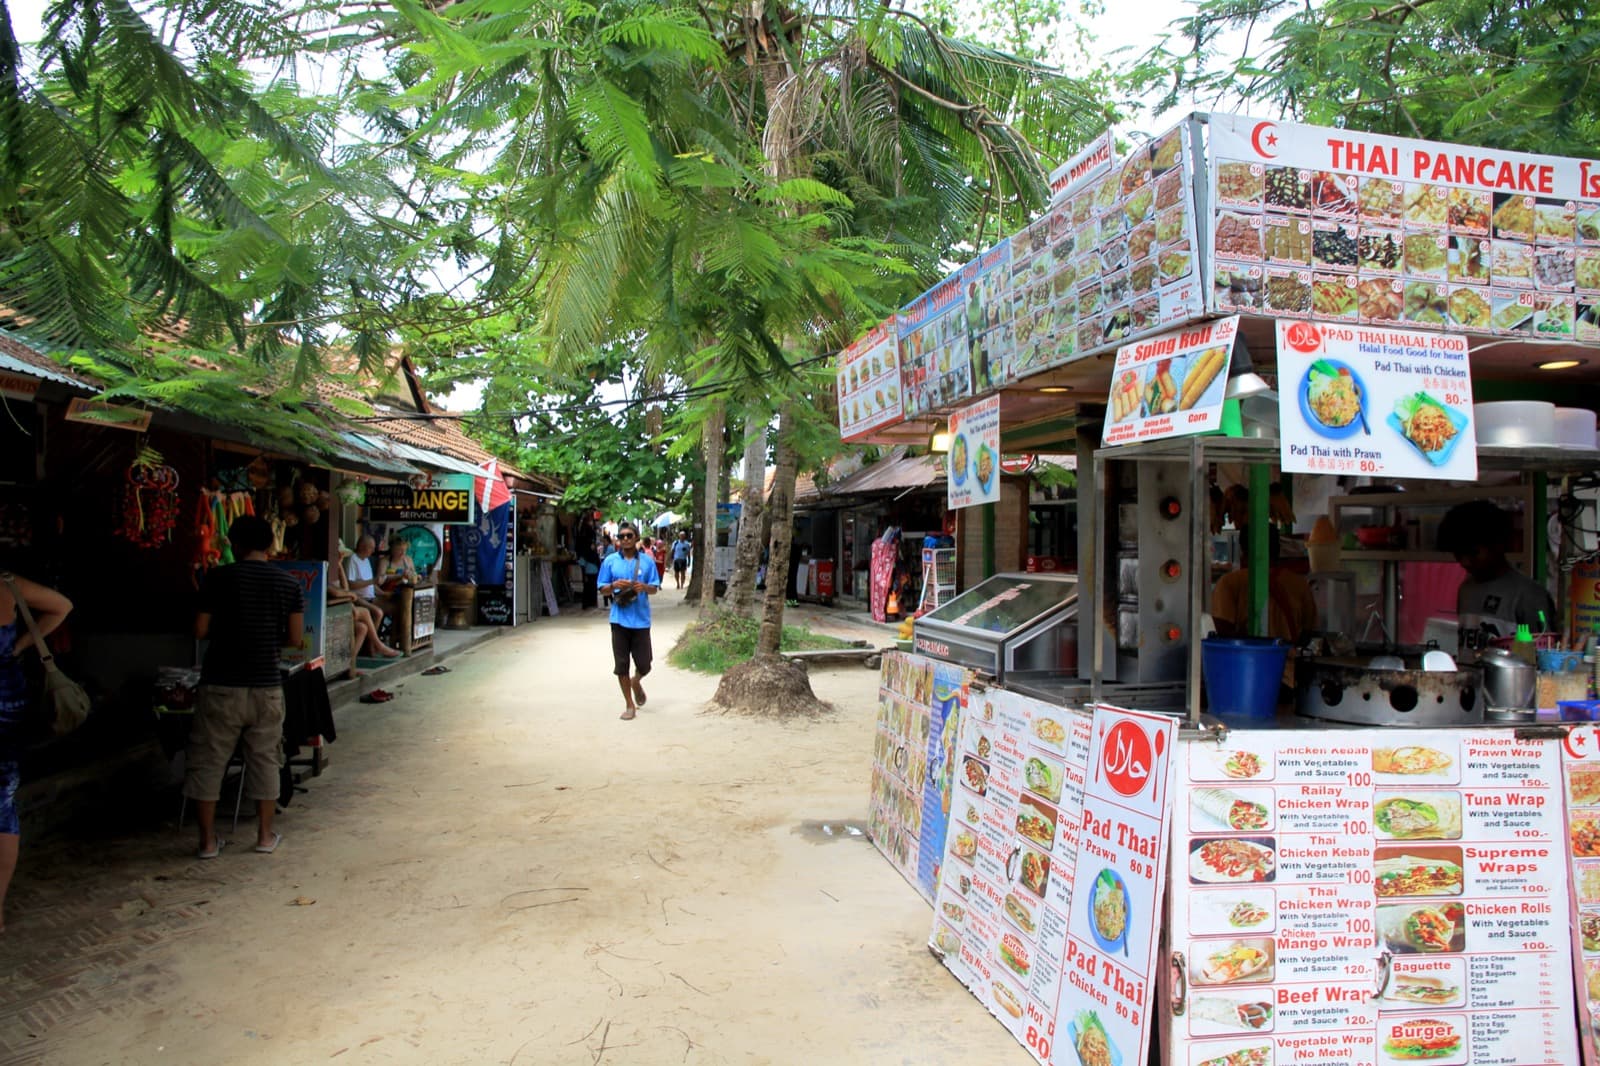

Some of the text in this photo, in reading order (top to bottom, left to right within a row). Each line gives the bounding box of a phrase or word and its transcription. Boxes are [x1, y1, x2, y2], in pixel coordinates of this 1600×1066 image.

[1070, 144, 1108, 180] PANCAKE
[1328, 139, 1553, 193] THAI PANCAKE
[1520, 294, 1532, 304] 80
[1134, 336, 1177, 361] Sping
[1180, 326, 1213, 350] Roll
[1328, 328, 1464, 351] PAD THAI HALAL FOOD
[1359, 344, 1464, 360] Halal Food Good for heart
[1375, 361, 1466, 378] Pad Thai with Chicken
[1446, 393, 1468, 404] 80.-
[1188, 412, 1208, 424] Corn
[1290, 444, 1382, 460] Pad Thai with Prawn
[1360, 460, 1384, 472] 80.-
[400, 512, 438, 520] SERVICE
[1469, 748, 1542, 758] Prawn Wrap
[1304, 760, 1358, 768] Vegetables
[1491, 762, 1540, 770] Vegetables
[1066, 767, 1083, 784] Tuna
[1302, 786, 1342, 796] Railay
[1278, 800, 1369, 810] Chicken Wrap
[1464, 793, 1544, 808] Tuna Wrap
[1492, 810, 1542, 818] Vegetables
[1082, 809, 1156, 860] Pad Thai
[1310, 836, 1336, 844] Thai
[1514, 830, 1548, 838] 100.-
[1086, 838, 1153, 880] Prawn 80 B
[1280, 848, 1370, 858] Chicken Kebab
[1466, 848, 1548, 860] Supreme
[1304, 862, 1357, 870] Vegetables
[1479, 862, 1538, 874] Wraps
[1308, 888, 1338, 896] Thai
[1279, 899, 1372, 910] Chicken Wrap
[1466, 902, 1552, 914] Chicken Rolls
[1496, 919, 1550, 928] Vegetables
[1282, 928, 1316, 938] Chicken
[1508, 930, 1536, 938] Sauce
[1003, 933, 1028, 960] Burger
[1278, 936, 1372, 950] Mango Wrap
[1522, 942, 1552, 950] 100.-
[962, 944, 991, 980] Egg Wrap
[1301, 956, 1348, 964] Vegetables
[1066, 940, 1096, 976] Pad
[1102, 960, 1143, 1006] Thai
[1344, 965, 1372, 974] 120.-
[1394, 962, 1452, 974] Baguette
[1069, 970, 1139, 1026] Chicken 80 B
[1278, 986, 1372, 1004] Beef Wrap
[1027, 1002, 1044, 1026] Hot
[1301, 1008, 1349, 1016] Vegetables
[1344, 1016, 1374, 1024] 120.-
[1392, 1025, 1454, 1040] Burger
[1026, 1025, 1050, 1059] 80
[1277, 1035, 1374, 1048] Vegetable Wrap
[1294, 1048, 1352, 1060] (No Meat)
